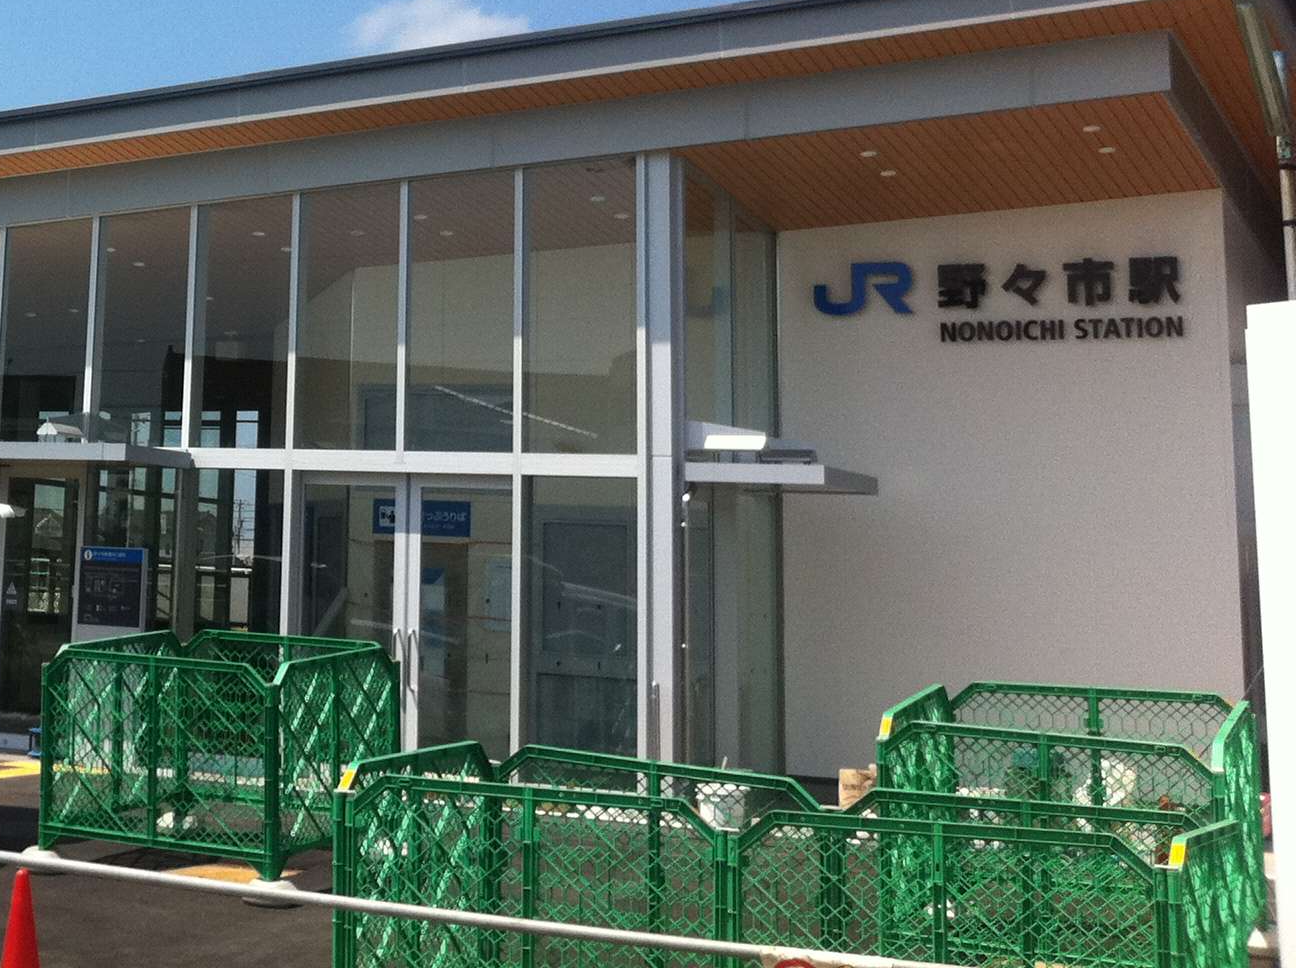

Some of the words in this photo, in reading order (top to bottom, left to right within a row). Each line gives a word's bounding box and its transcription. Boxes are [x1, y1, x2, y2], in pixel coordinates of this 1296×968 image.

[813, 261, 913, 316] JR
[937, 255, 1182, 310] 野々市駅
[939, 320, 1065, 343] NONOICHI
[1074, 315, 1185, 340] STATION
